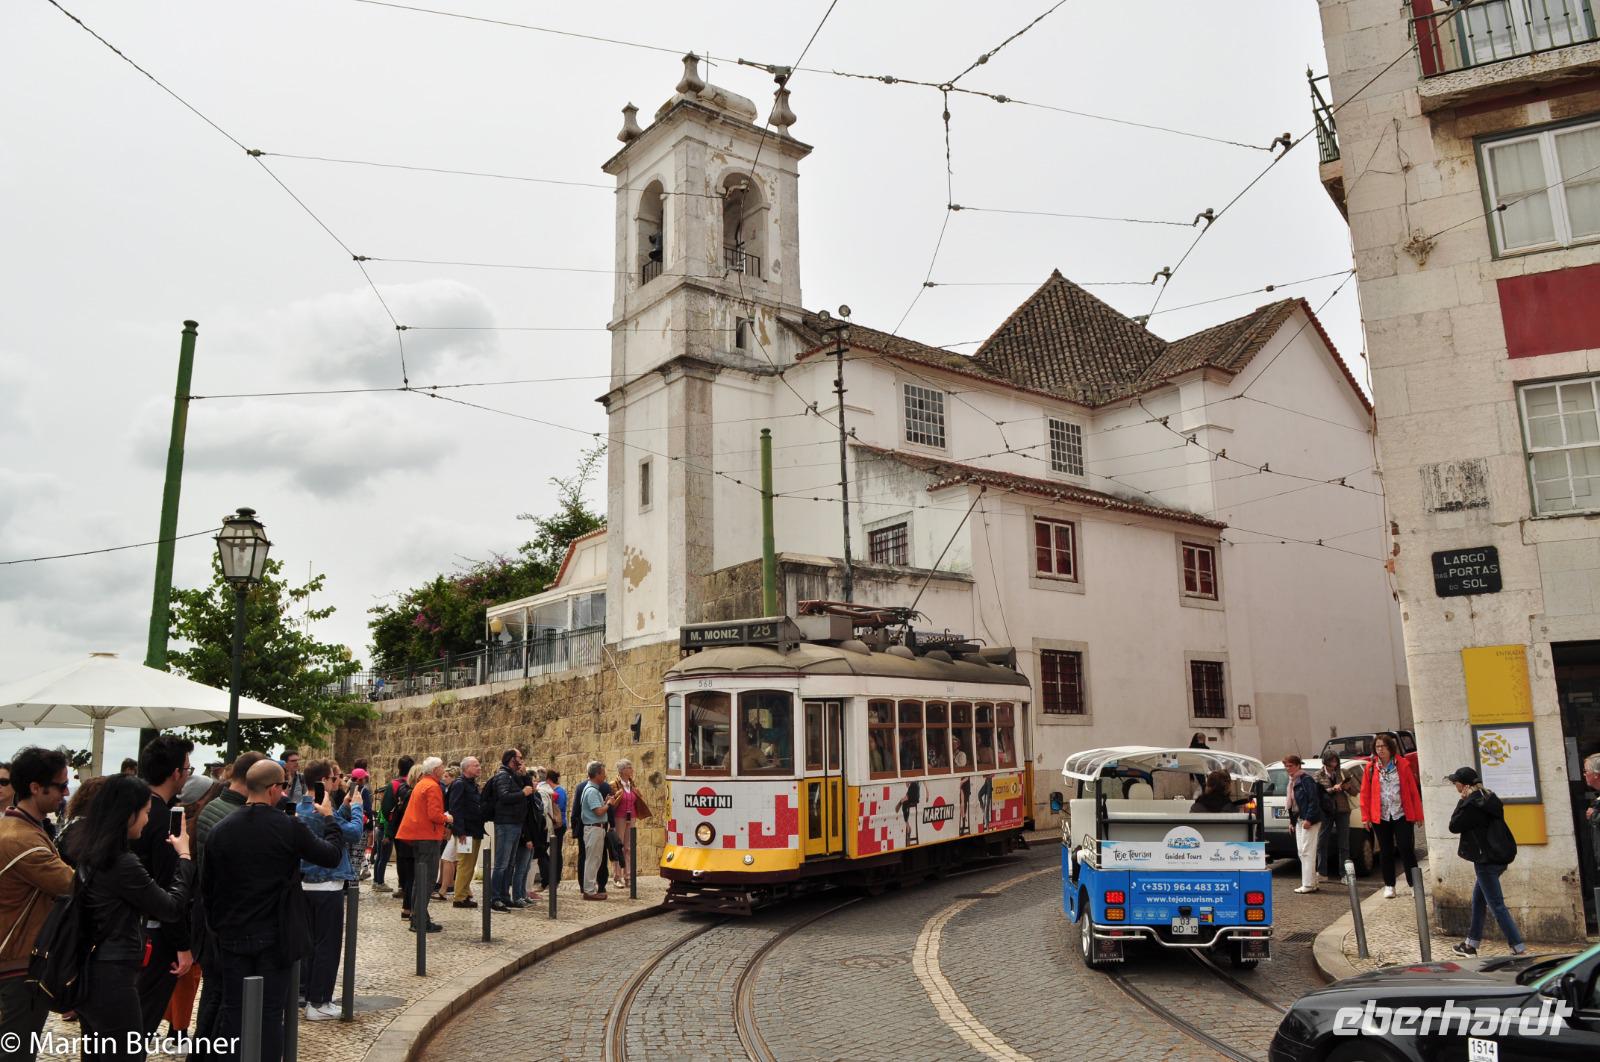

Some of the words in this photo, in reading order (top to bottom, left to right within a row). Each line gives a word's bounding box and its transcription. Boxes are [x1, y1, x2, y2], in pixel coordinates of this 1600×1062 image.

[1443, 553, 1486, 565] LARGO
[1449, 564, 1498, 578] PORTAS
[1462, 578, 1488, 589] SOL
[690, 631, 702, 641] M.
[704, 629, 740, 640] MONIZ
[752, 624, 771, 638] 28
[698, 680, 713, 688] 568
[685, 795, 732, 808] MARTINI
[923, 805, 954, 822] MARTINI
[1142, 883, 1171, 891] (+351)
[1173, 883, 1192, 891] 964
[1194, 883, 1212, 891] 483
[1214, 883, 1230, 891] 321
[1146, 896, 1224, 904] www.tejotourism.pt
[1190, 925, 1198, 934] 12
[1472, 1040, 1495, 1056] 1514
